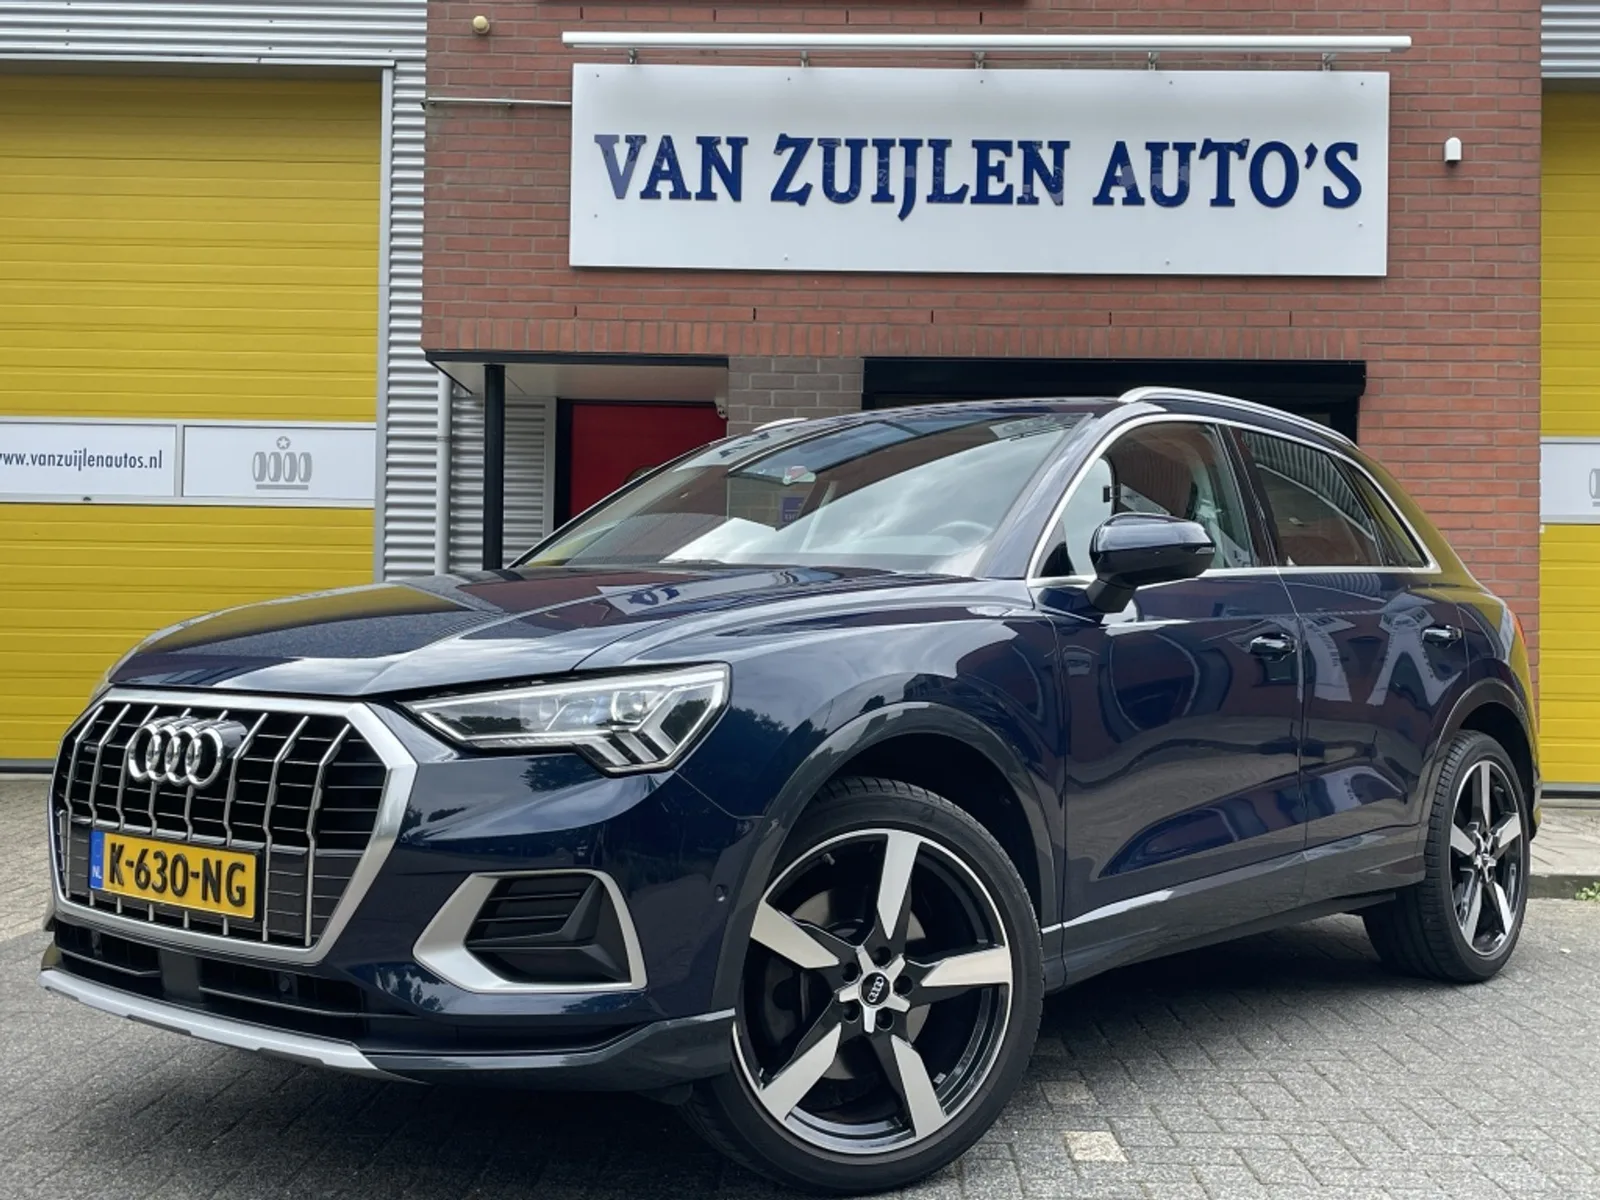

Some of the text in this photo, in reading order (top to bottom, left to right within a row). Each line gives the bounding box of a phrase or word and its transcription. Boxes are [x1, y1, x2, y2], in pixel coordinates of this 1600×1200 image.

[594, 133, 1362, 221] VAN ZUIJLEN AUTO'S
[0, 447, 163, 471] ww.vanzuijlenautos.nl
[91, 865, 103, 880] NL
[109, 842, 247, 908] K-630-NG
